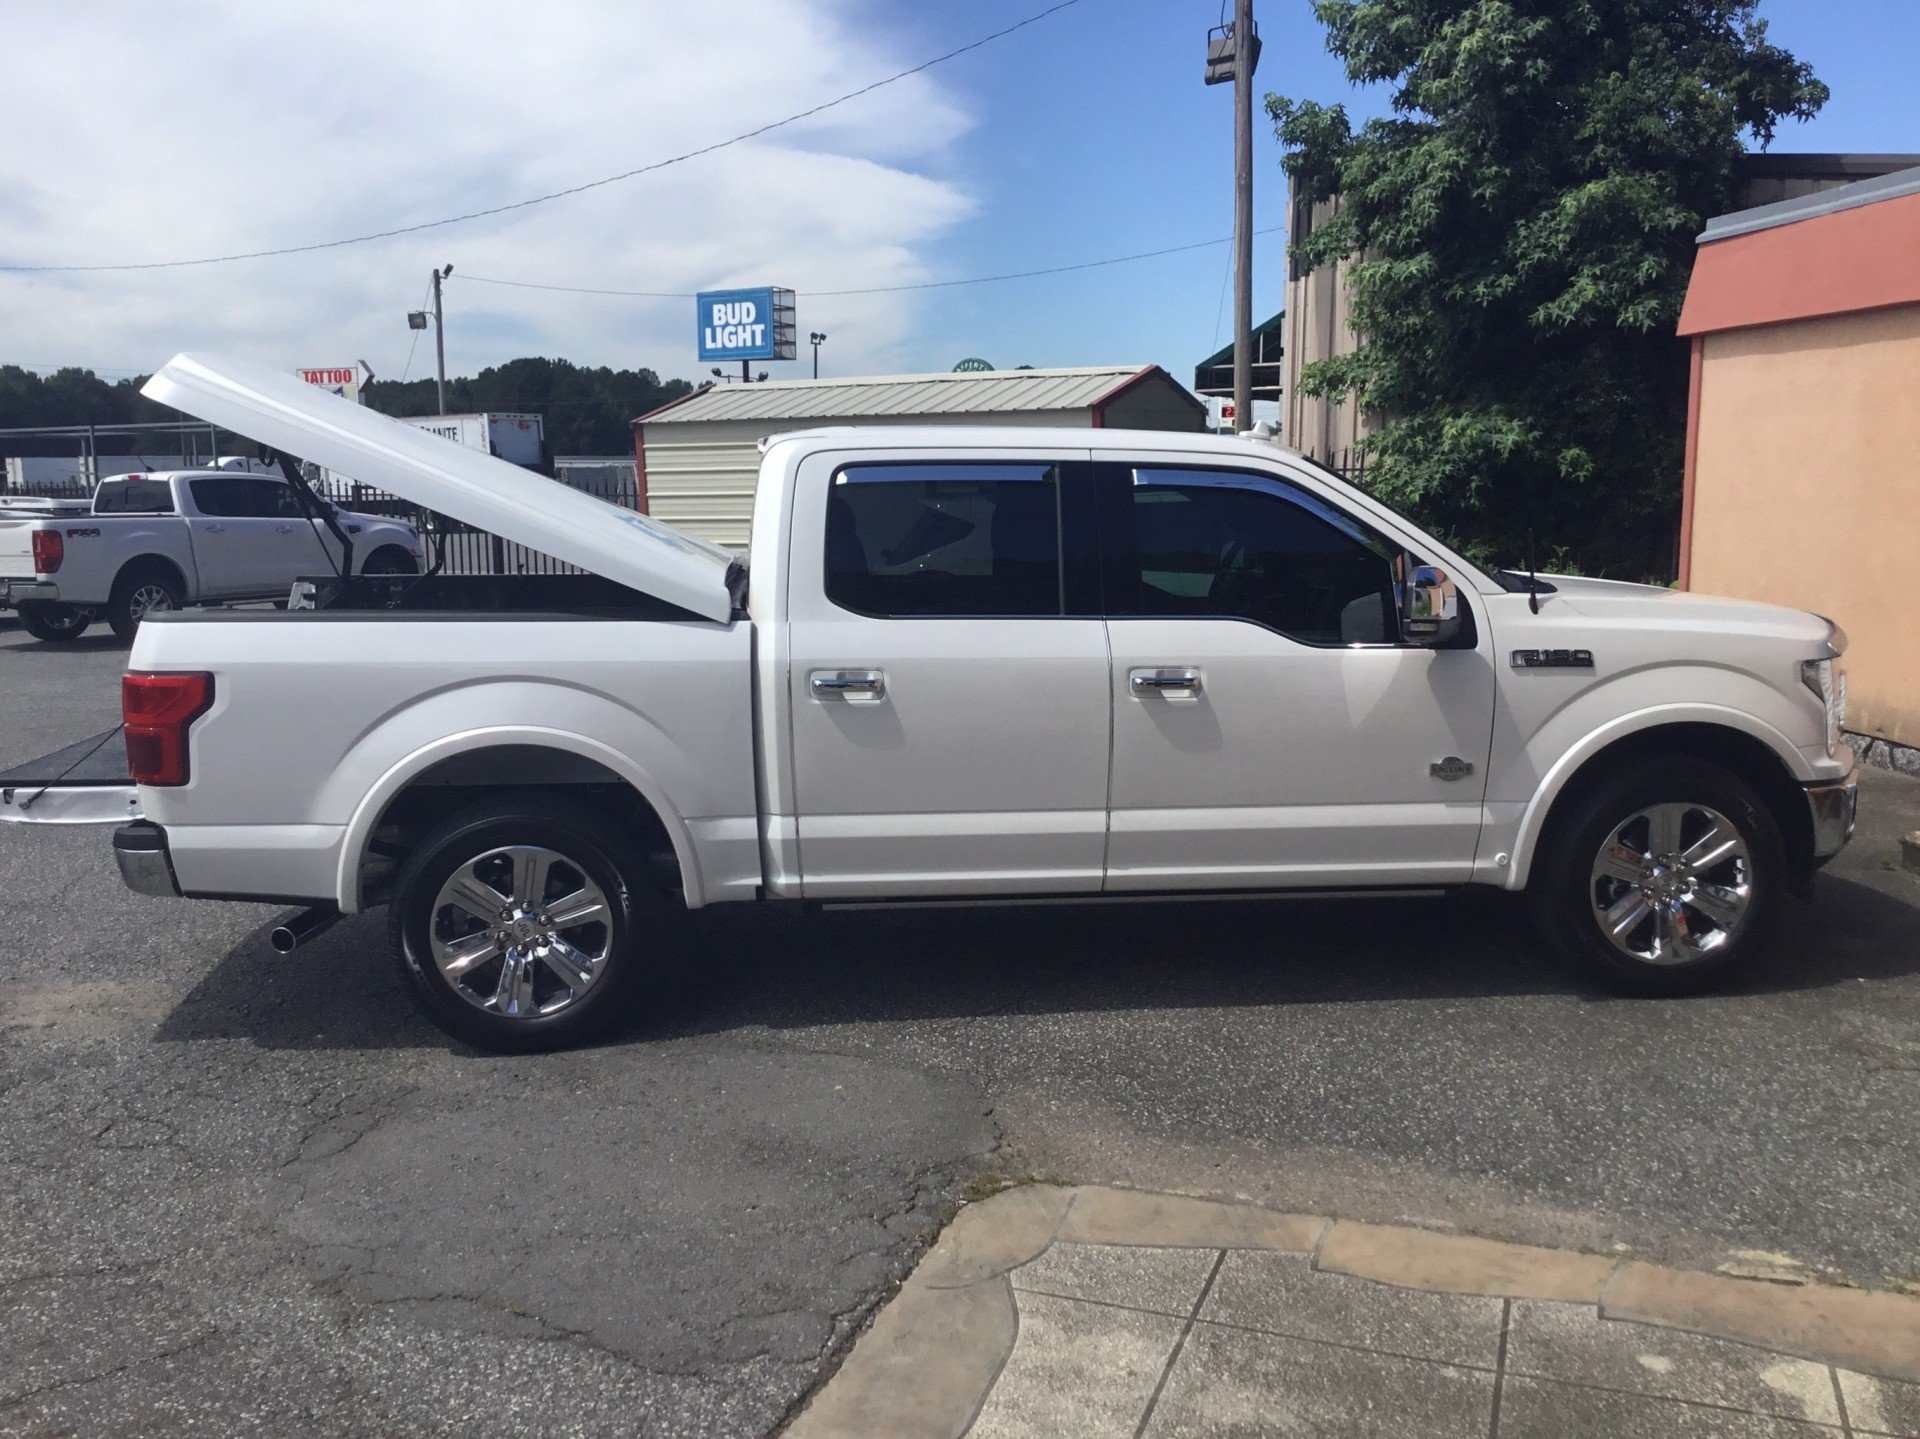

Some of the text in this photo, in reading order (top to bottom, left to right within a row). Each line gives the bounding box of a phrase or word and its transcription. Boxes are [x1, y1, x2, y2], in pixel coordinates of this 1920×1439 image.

[712, 301, 756, 326] BUD
[704, 323, 765, 349] LIGHT
[303, 369, 352, 384] TATTOO
[420, 426, 459, 442] NITE
